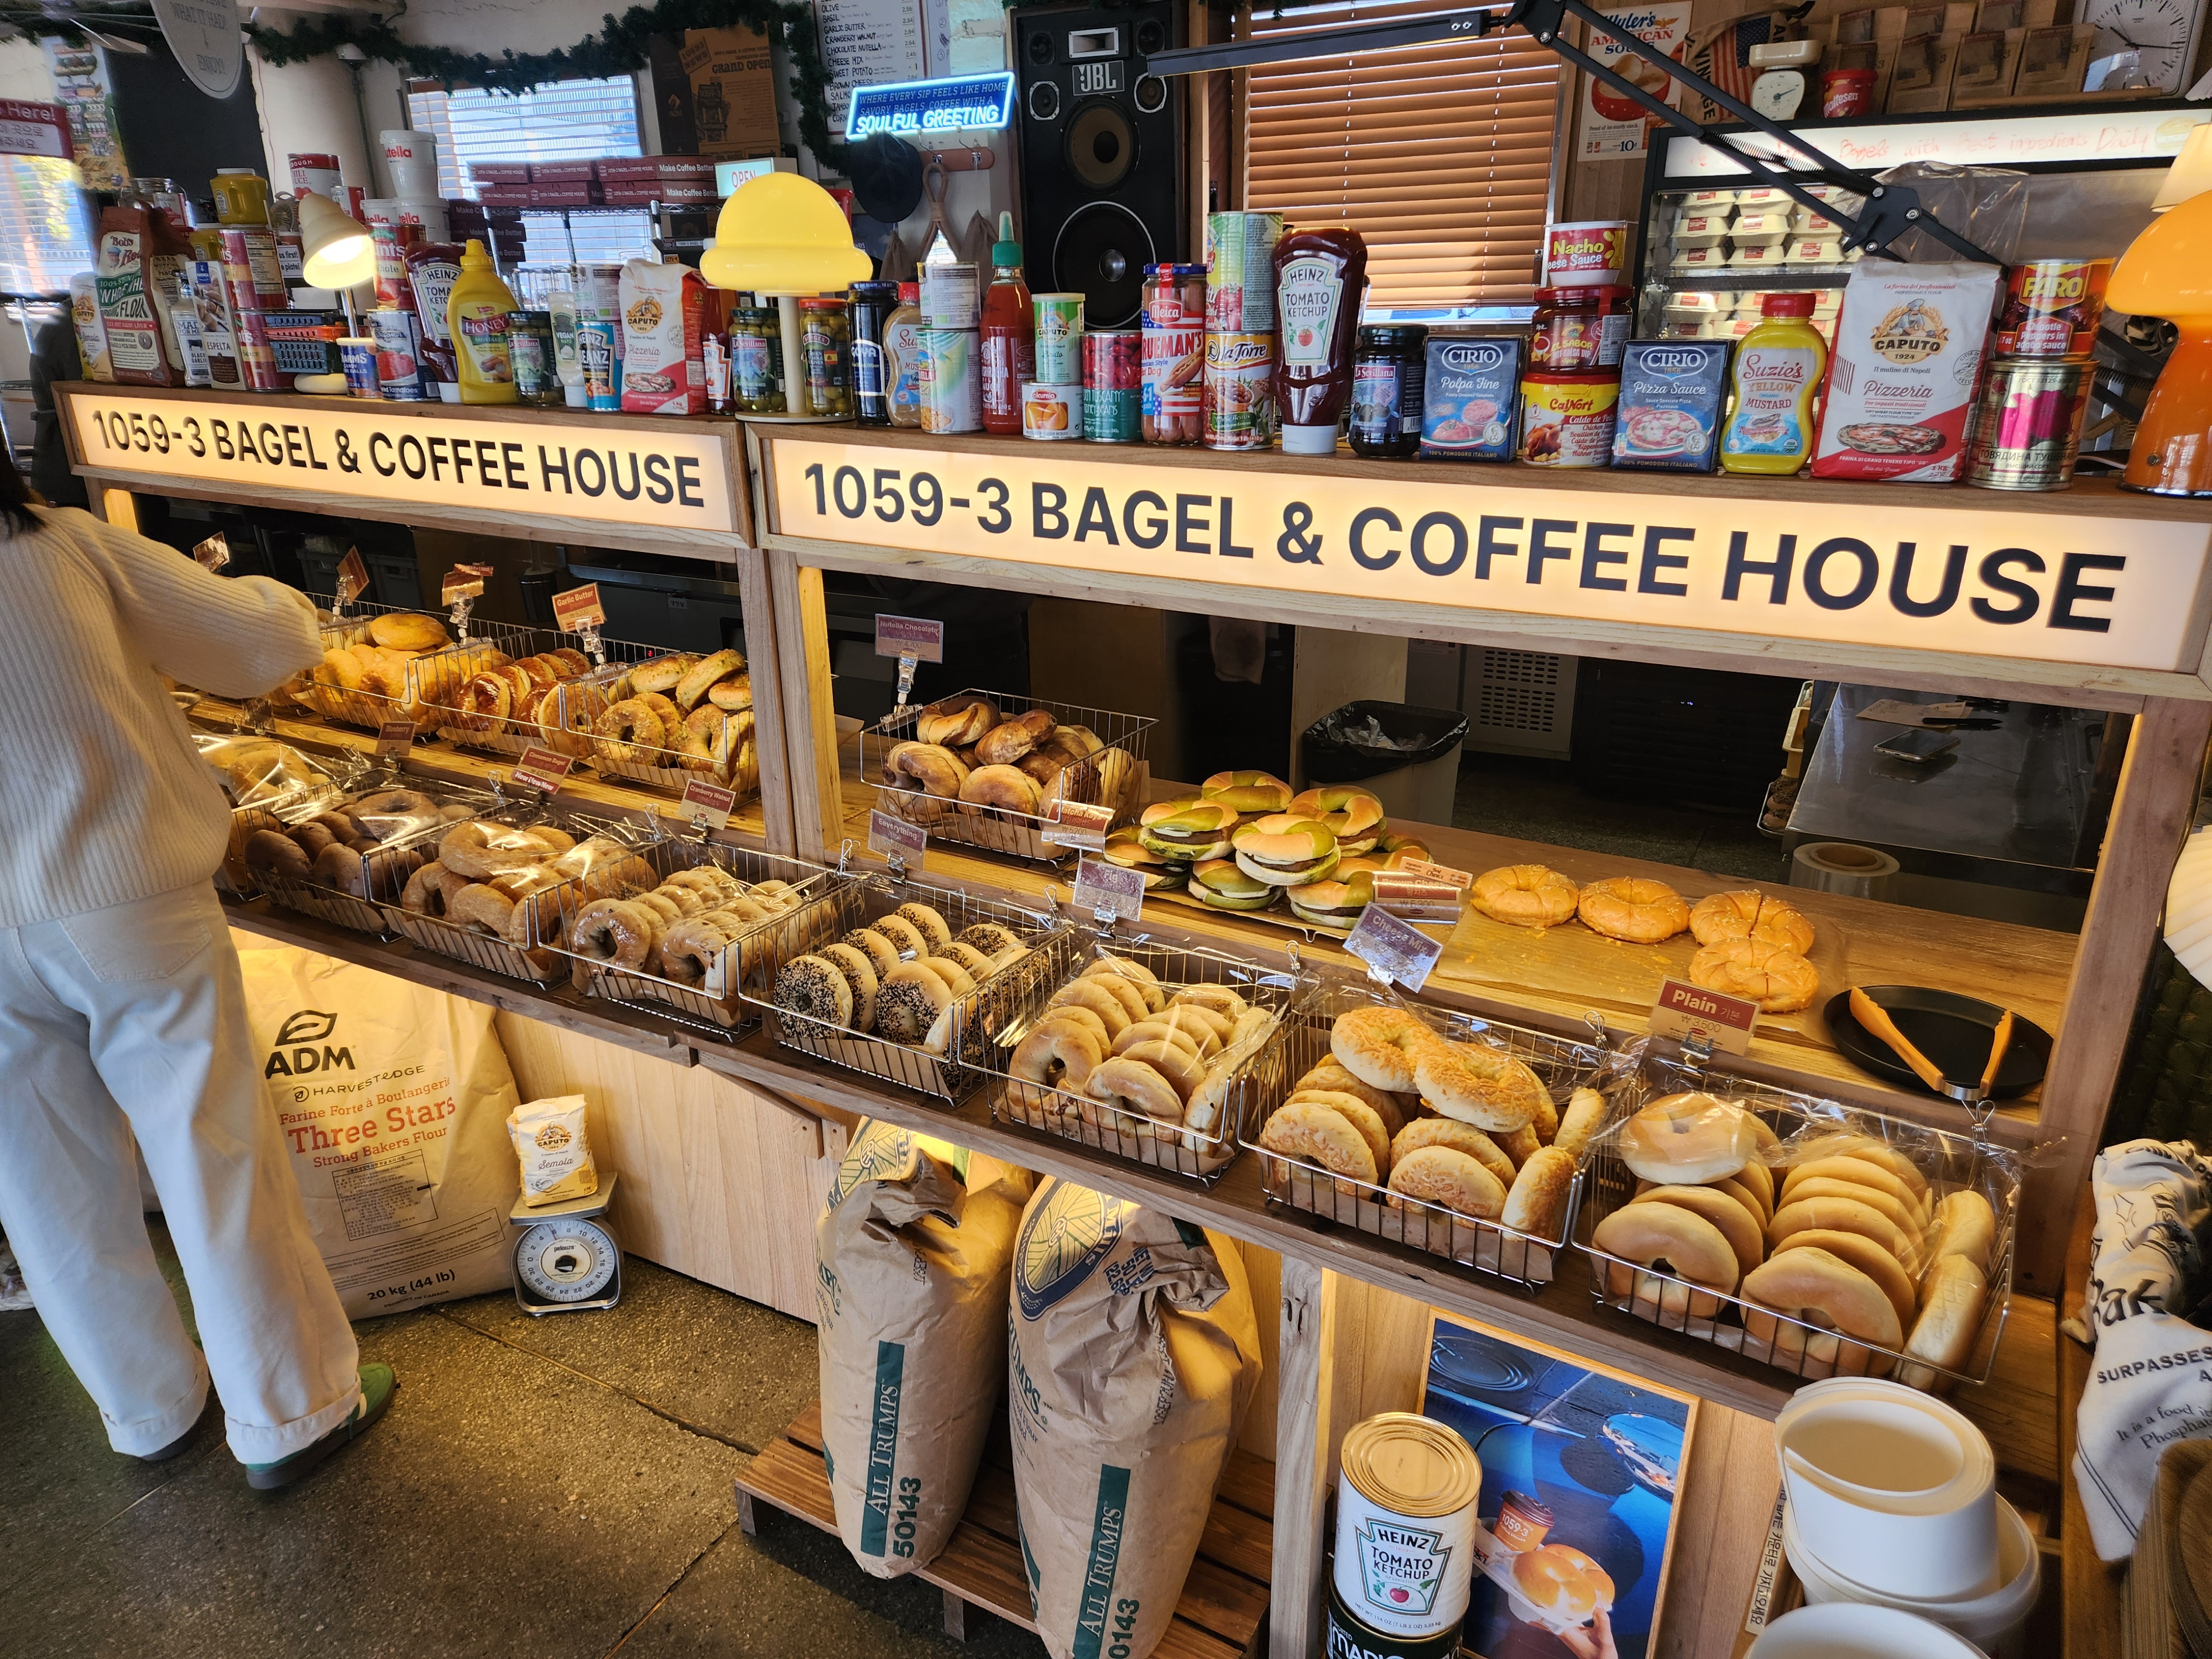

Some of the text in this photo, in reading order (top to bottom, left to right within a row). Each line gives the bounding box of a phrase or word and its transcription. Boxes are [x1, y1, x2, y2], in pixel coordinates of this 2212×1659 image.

[821, 4, 839, 13] OLIVE
[823, 14, 839, 23] BASIL
[824, 23, 865, 34] GARLIC BUTTER
[825, 33, 876, 44] CRANBERRY WALNUT
[826, 43, 881, 56] CHOCOLATE NUTELLA
[828, 56, 863, 67] CHEESE MIX
[829, 69, 849, 80] SWEET
[1079, 64, 1116, 92] JBL
[859, 82, 1007, 104] WHERE EVERY SIP FEELS LIKE HOME
[7, 101, 55, 121] Here!
[856, 105, 999, 133] SOULFUL GREETING
[659, 163, 714, 172] Make Coffee Better
[666, 188, 681, 197] Make
[681, 188, 702, 197] Coffee
[1553, 238, 1604, 255] Nacho
[426, 269, 458, 281] HEINZ
[1290, 269, 1324, 284] HEINZ
[2022, 276, 2084, 298] FARO
[1286, 292, 1329, 306] TOMATO
[1151, 305, 1179, 318] Meica
[1287, 306, 1327, 317] KETCHUP
[466, 318, 505, 333] HONEY
[628, 317, 658, 326] CAPUTO
[2027, 322, 2062, 331] Chipotle
[805, 334, 828, 342] BORGES
[2021, 332, 2064, 341] Peppers in
[207, 342, 231, 351] ESPELTA
[629, 344, 660, 356] Pizzeria
[851, 346, 877, 357] GOYA
[1551, 340, 1593, 351] EL SABOR
[1874, 339, 1941, 351] CAPUTO
[1448, 349, 1496, 363] CIRIO
[1647, 353, 1700, 367] CIRIO
[1147, 367, 1161, 377] Dog
[1355, 367, 1394, 377] La Sevillana
[1441, 376, 1500, 393] Polpa Fine
[1634, 381, 1707, 395] Pizza Sauce
[1747, 382, 1796, 393] YELLOW
[1863, 380, 1933, 398] Pizzeria
[1550, 398, 1594, 412] CalNort
[1745, 398, 1791, 409] MUSTARD
[92, 409, 705, 508] 1059-3 BAGEL & COFFEE HOUSE
[1980, 449, 2031, 462] ГОВЯДИНА
[805, 462, 2127, 634] 1059-3 BAGEL & COFFEE HOUSE
[557, 591, 593, 606] Garlic Butter
[880, 620, 939, 633] Nutella Chocolate
[529, 752, 566, 766] Cinnamon Bagel
[690, 785, 731, 802] Cranberry Walnut
[879, 818, 917, 841] Eeverything
[1104, 870, 1118, 883] Fig
[1373, 915, 1428, 953] Cheese Mix
[1672, 989, 1740, 1021] Plain 기본
[264, 1046, 356, 1079] ADM
[279, 1077, 450, 1125] Farine Forte à Boulangerie
[288, 1097, 456, 1154] Three Stars
[313, 1127, 447, 1168] Strong Bakers Flour
[537, 1138, 570, 1147] CAPUTO
[538, 1157, 574, 1171] Semola
[367, 1269, 456, 1301] 20 kg (44 lb)
[2096, 1346, 2212, 1384] SURPASSES
[2116, 1404, 2195, 1442] It is a food
[892, 1477, 921, 1559] 50143
[1501, 1512, 1529, 1537] 1059-3
[1377, 1528, 1430, 1550] HEINZ
[1764, 1531, 1782, 1567] 카운터로
[1371, 1546, 1433, 1570] TOMATO
[1373, 1559, 1430, 1580] KETCHUP
